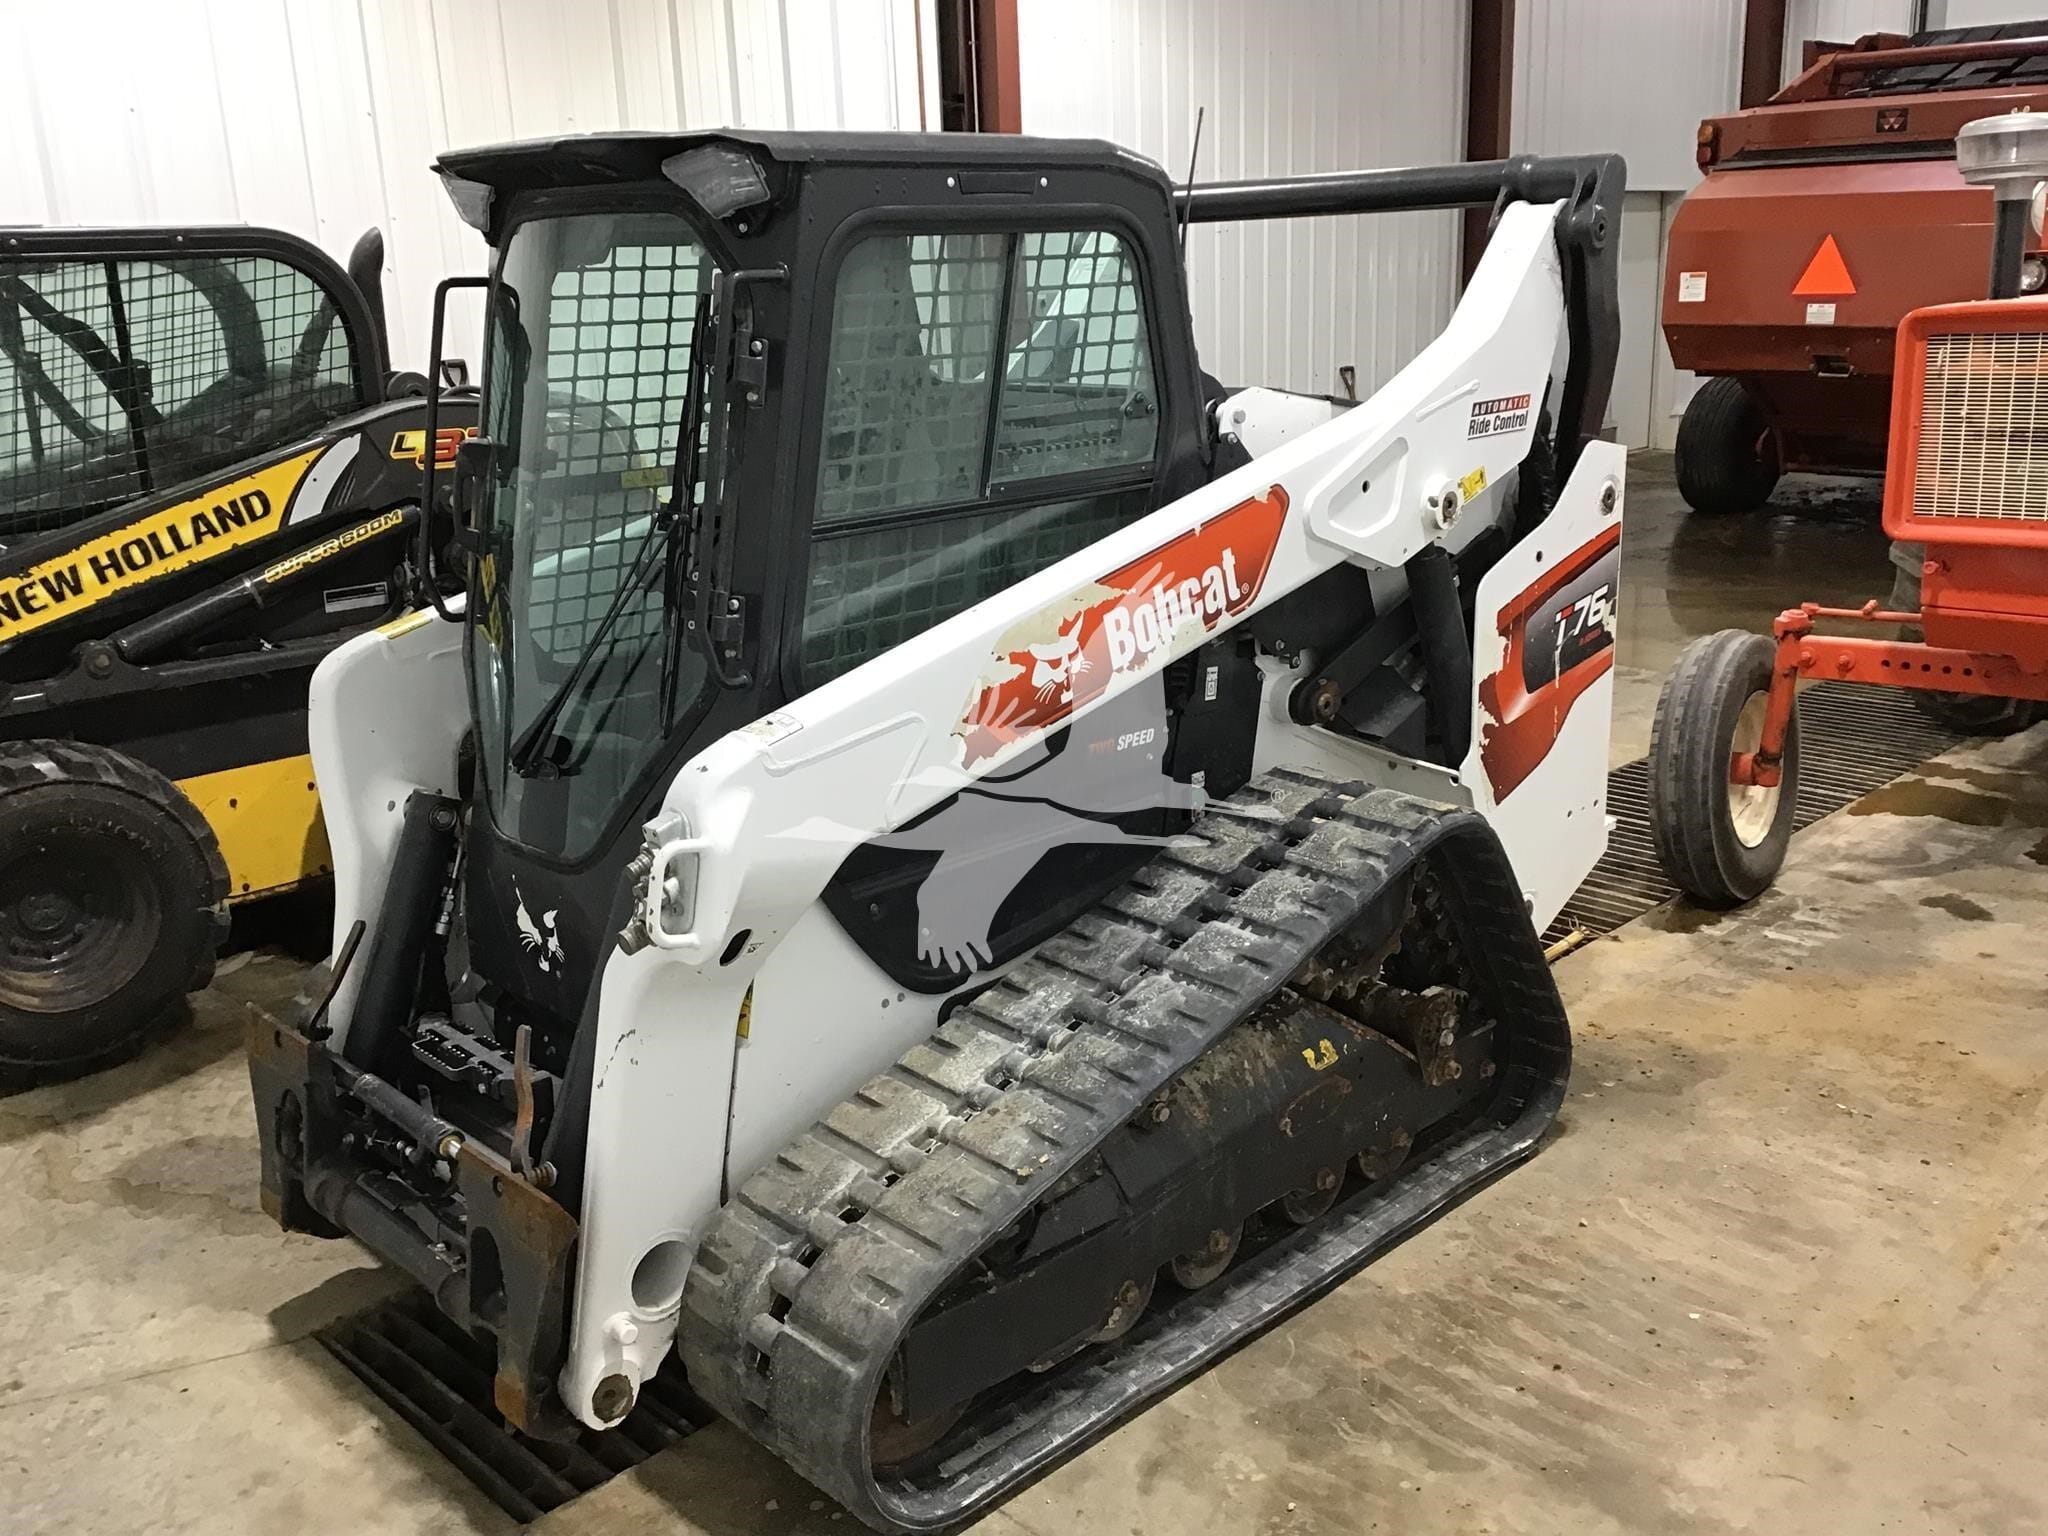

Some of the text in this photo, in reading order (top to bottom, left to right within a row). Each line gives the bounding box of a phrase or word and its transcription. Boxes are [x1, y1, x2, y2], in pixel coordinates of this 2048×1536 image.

[1468, 409, 1529, 436] Ride Control
[1473, 395, 1529, 416] AUTOMATIC
[390, 427, 479, 470] L3
[0, 488, 272, 628] NEW HOLLAND
[265, 508, 403, 583] SUPER BOOM
[1103, 547, 1241, 673] Bobcat
[1116, 727, 1155, 751] SPEED
